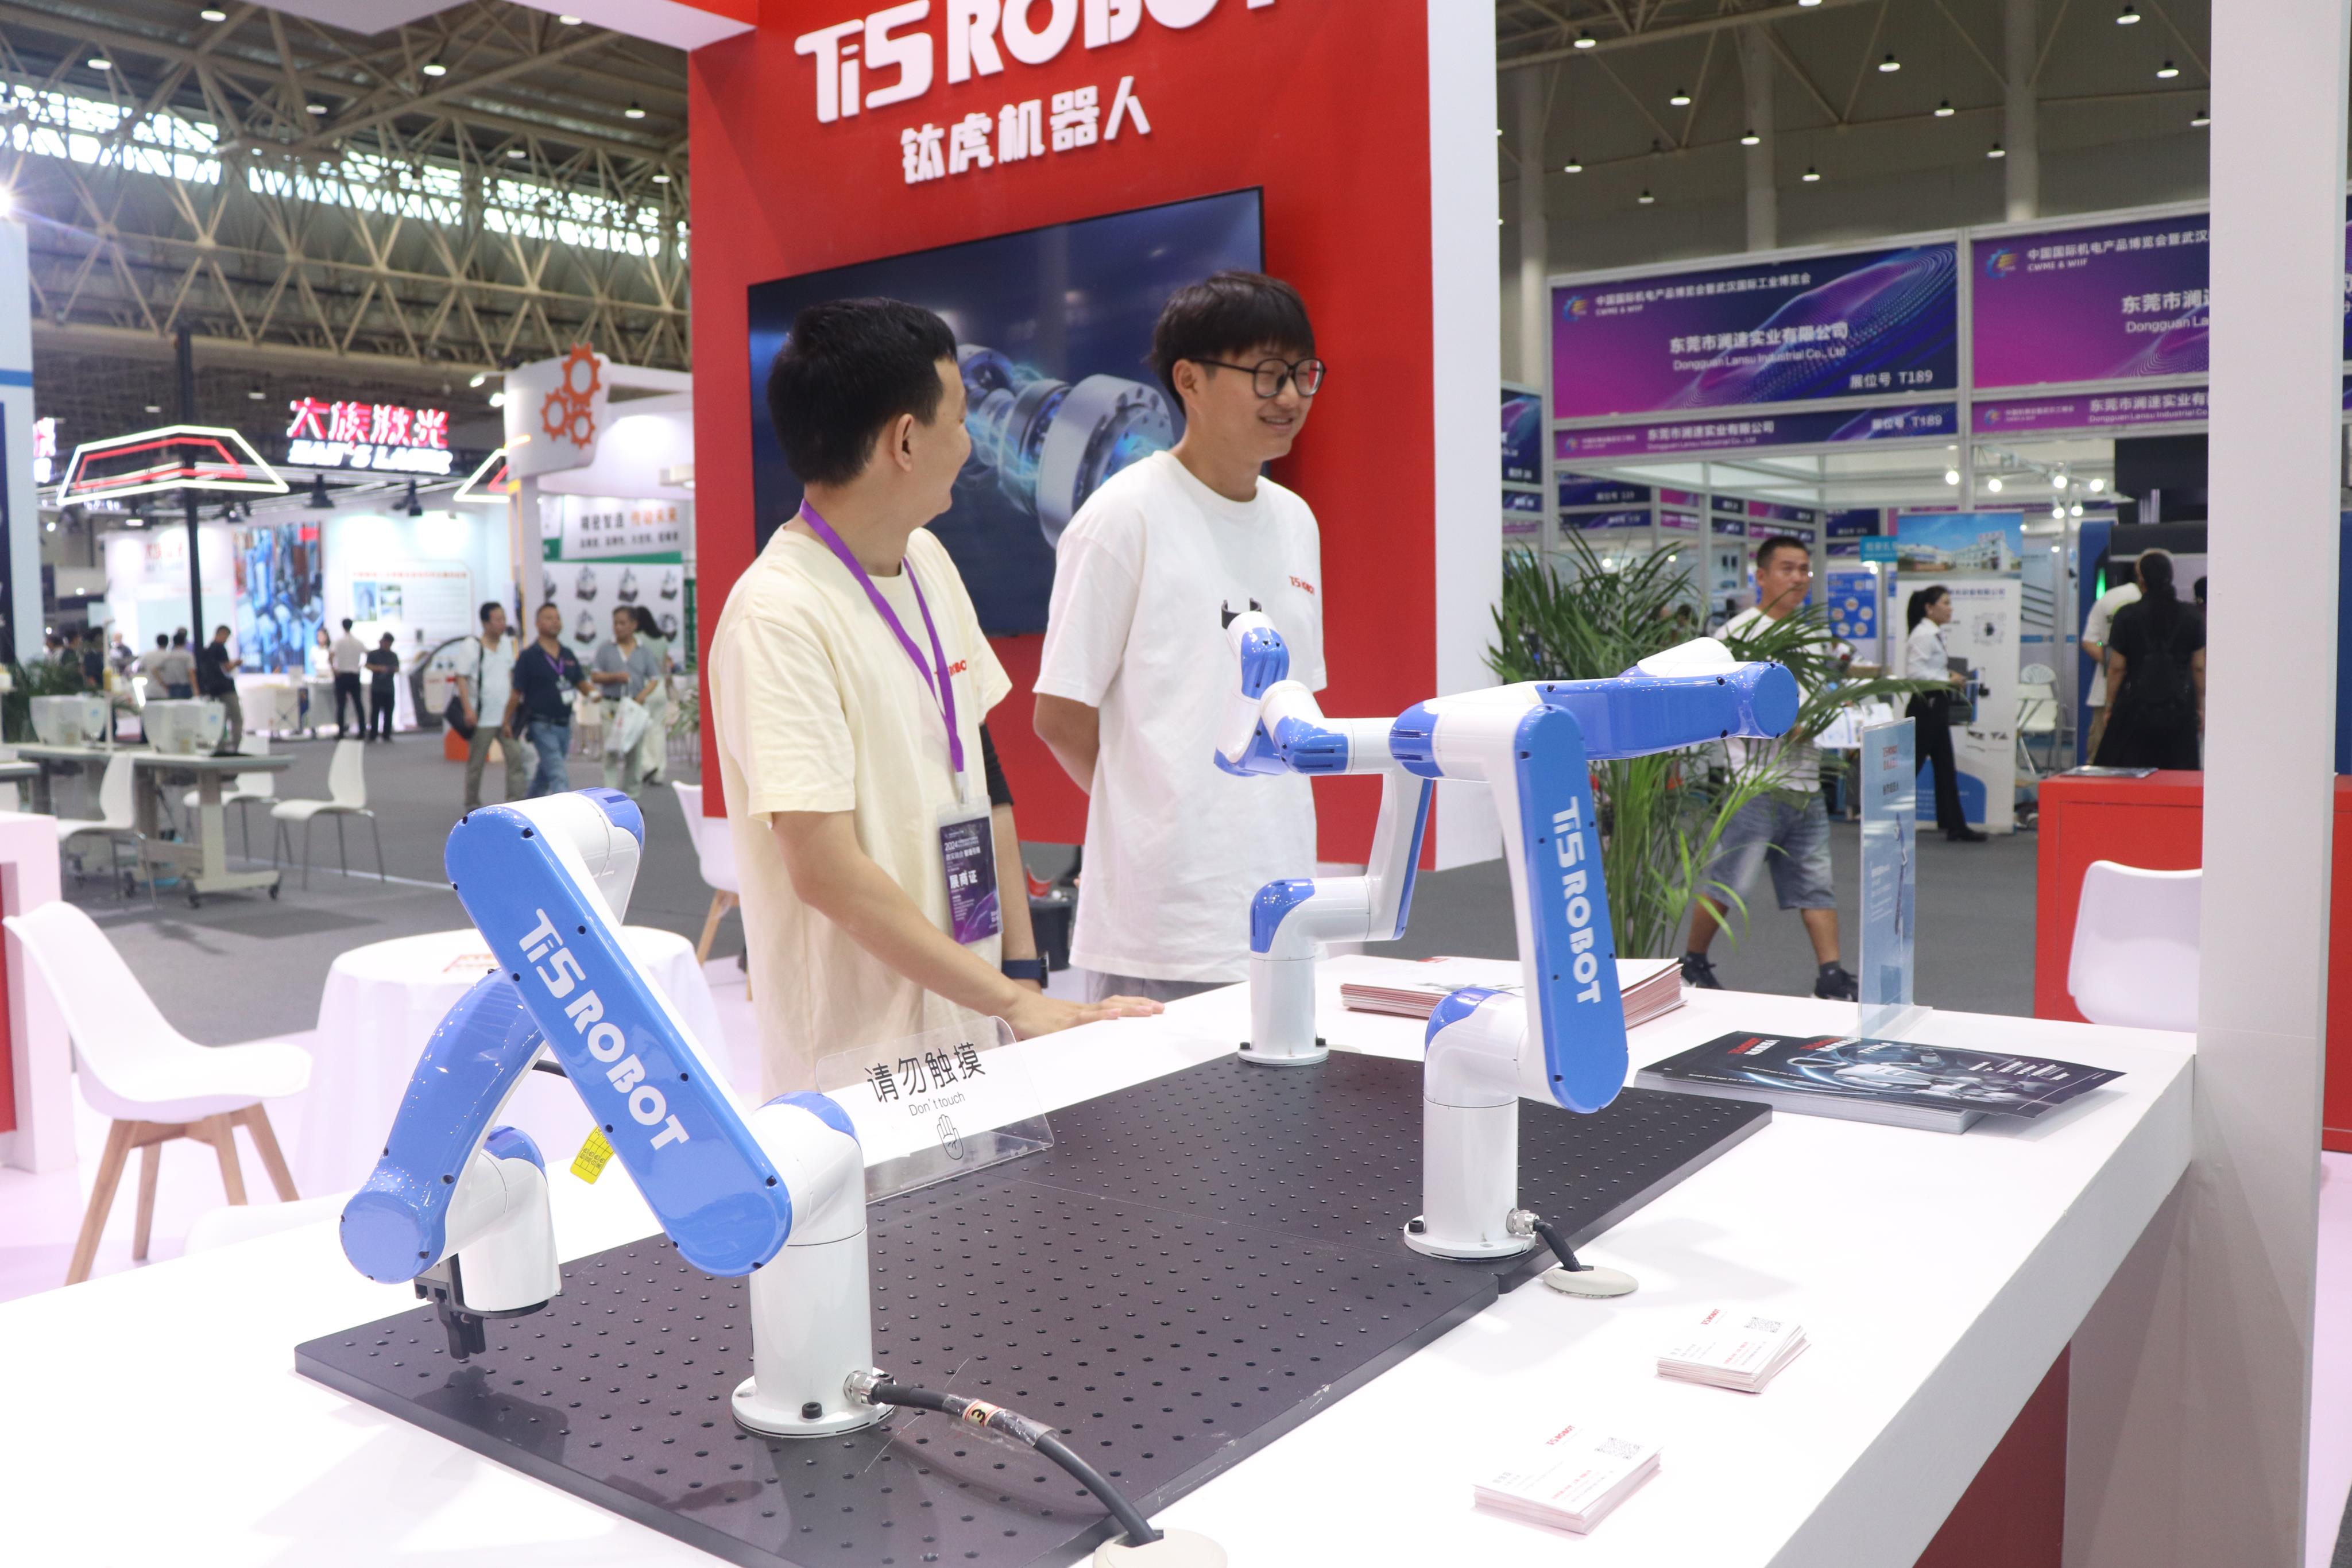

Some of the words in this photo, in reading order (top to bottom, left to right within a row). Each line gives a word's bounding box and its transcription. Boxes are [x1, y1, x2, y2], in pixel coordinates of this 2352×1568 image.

[947, 0, 1275, 84] ROB
[901, 76, 1151, 184] 钛虎机器人
[2127, 319, 2190, 333] Dongguan
[1850, 371, 1891, 389] 展位号
[1898, 370, 1933, 385] T189
[1562, 869, 1601, 1004] ROBOT
[564, 989, 690, 1151] ROBOT
[864, 1042, 986, 1104] 请勿触摸
[938, 1091, 966, 1108] touch
